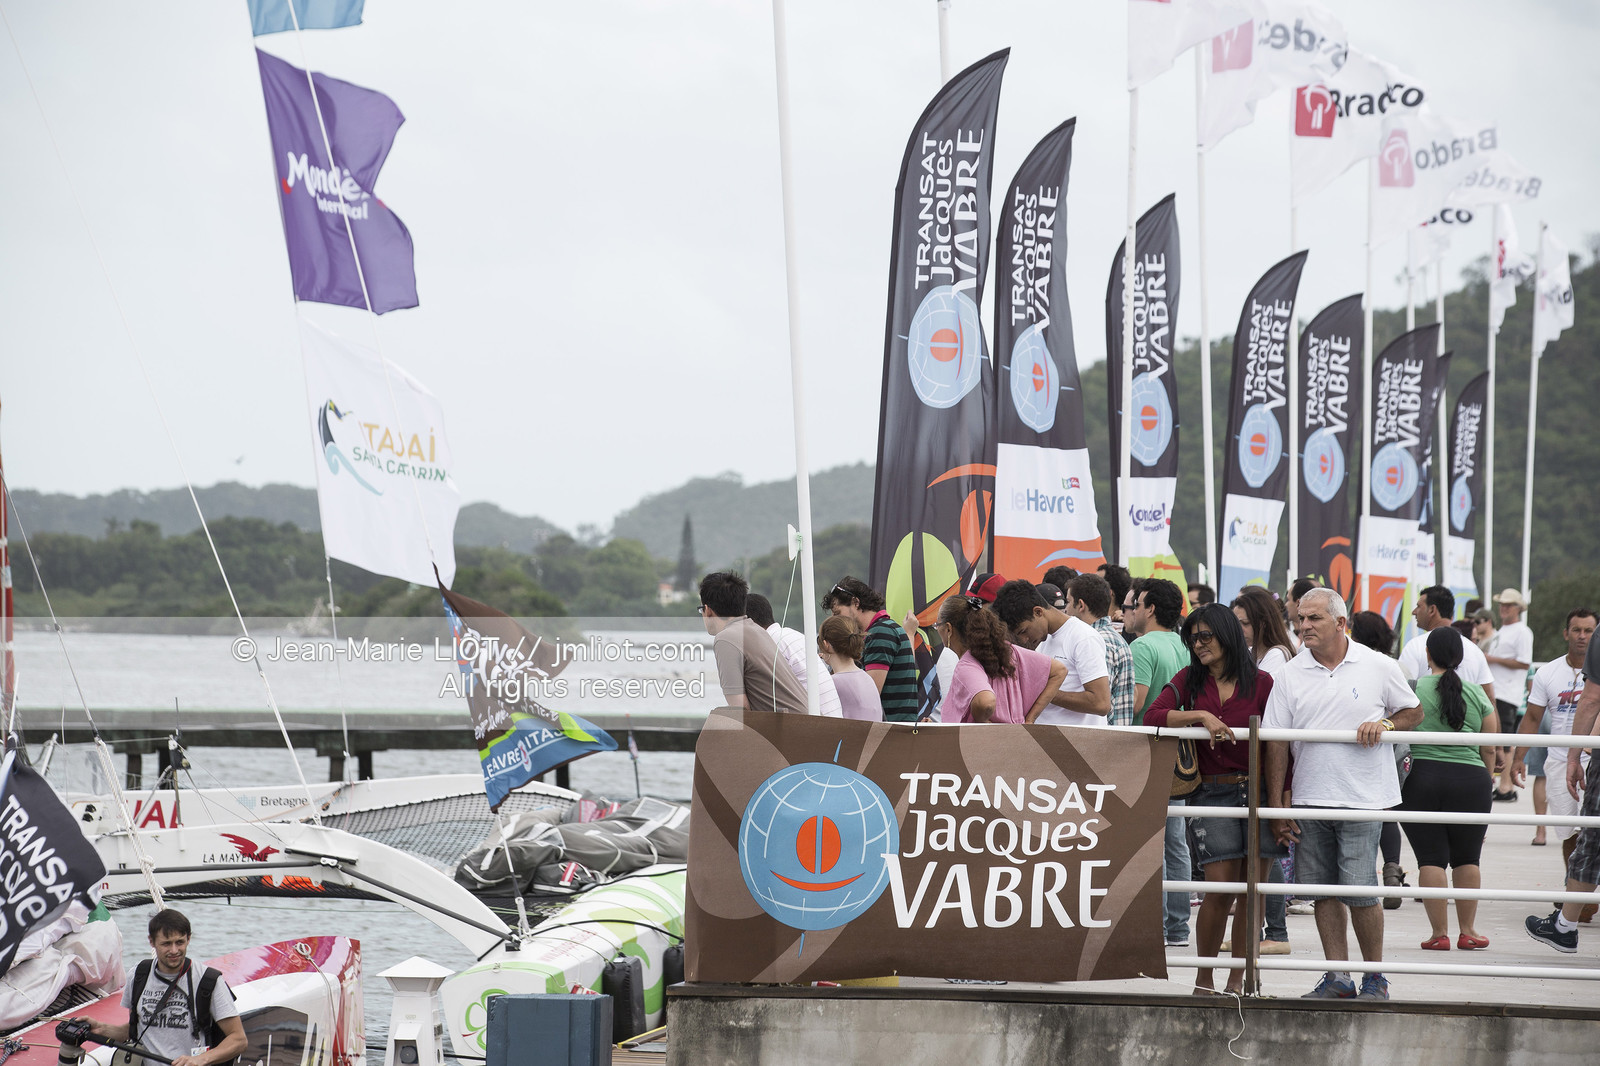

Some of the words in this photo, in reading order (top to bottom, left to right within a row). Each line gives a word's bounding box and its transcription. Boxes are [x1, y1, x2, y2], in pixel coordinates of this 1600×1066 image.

[914, 131, 937, 290] TRANSAT
[930, 138, 954, 282] Jacques
[951, 128, 984, 299] VABRE
[1012, 186, 1026, 326] TRANSAT
[1025, 194, 1038, 320] Jacques
[1034, 185, 1059, 336] VABRE
[1145, 252, 1169, 382] VABRE
[1243, 299, 1262, 406] TRANSAT
[1262, 299, 1292, 414] VABRE
[1305, 332, 1320, 429] TRANSAT
[1323, 334, 1351, 436] VABRE
[1374, 358, 1394, 445] TRANSAT
[1396, 358, 1423, 450] VABRE
[261, 796, 308, 808] Bretagne
[900, 773, 1117, 815] TRANSAT
[903, 809, 1099, 864] Jacques
[0, 794, 76, 904] TRANSA
[203, 853, 215, 863] LA
[219, 852, 269, 864] MAYENNE
[880, 853, 1112, 929] VABRE
